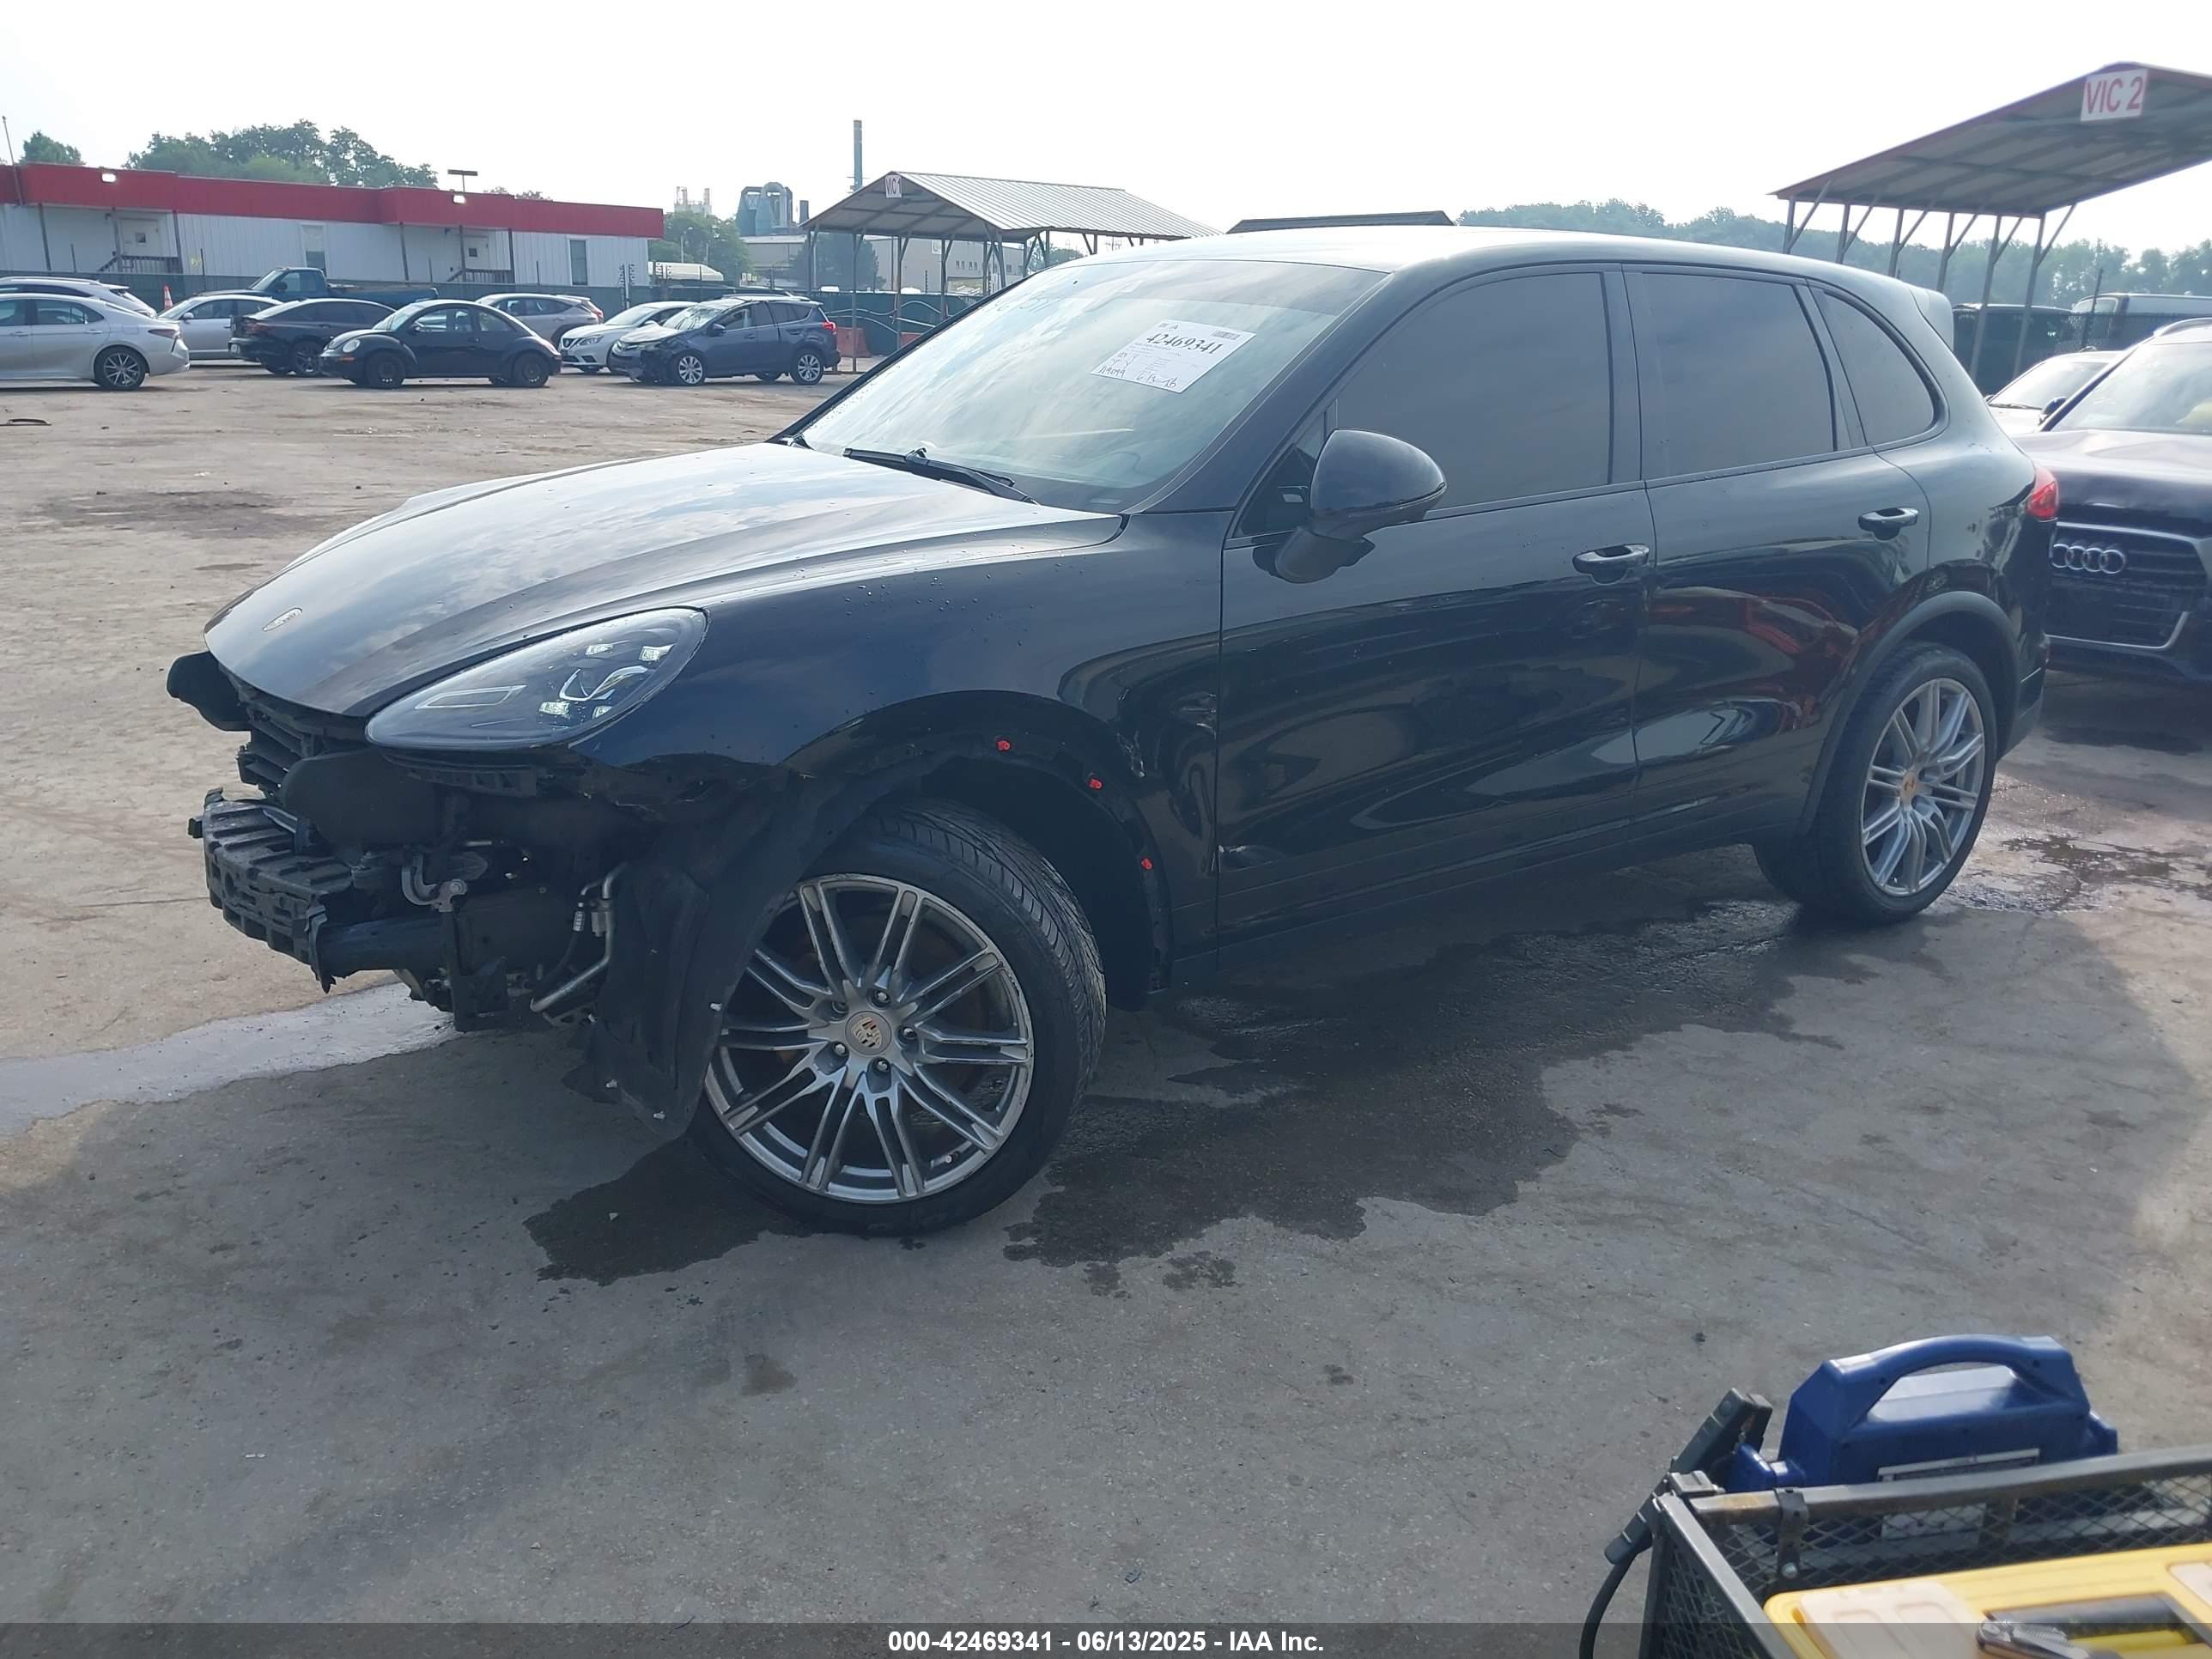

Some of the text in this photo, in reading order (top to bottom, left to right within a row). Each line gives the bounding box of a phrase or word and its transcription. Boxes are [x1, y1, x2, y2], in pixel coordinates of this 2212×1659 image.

[2087, 76, 2143, 113] VIC 2
[886, 178, 896, 194] VIC
[1146, 333, 1224, 355] 42469341
